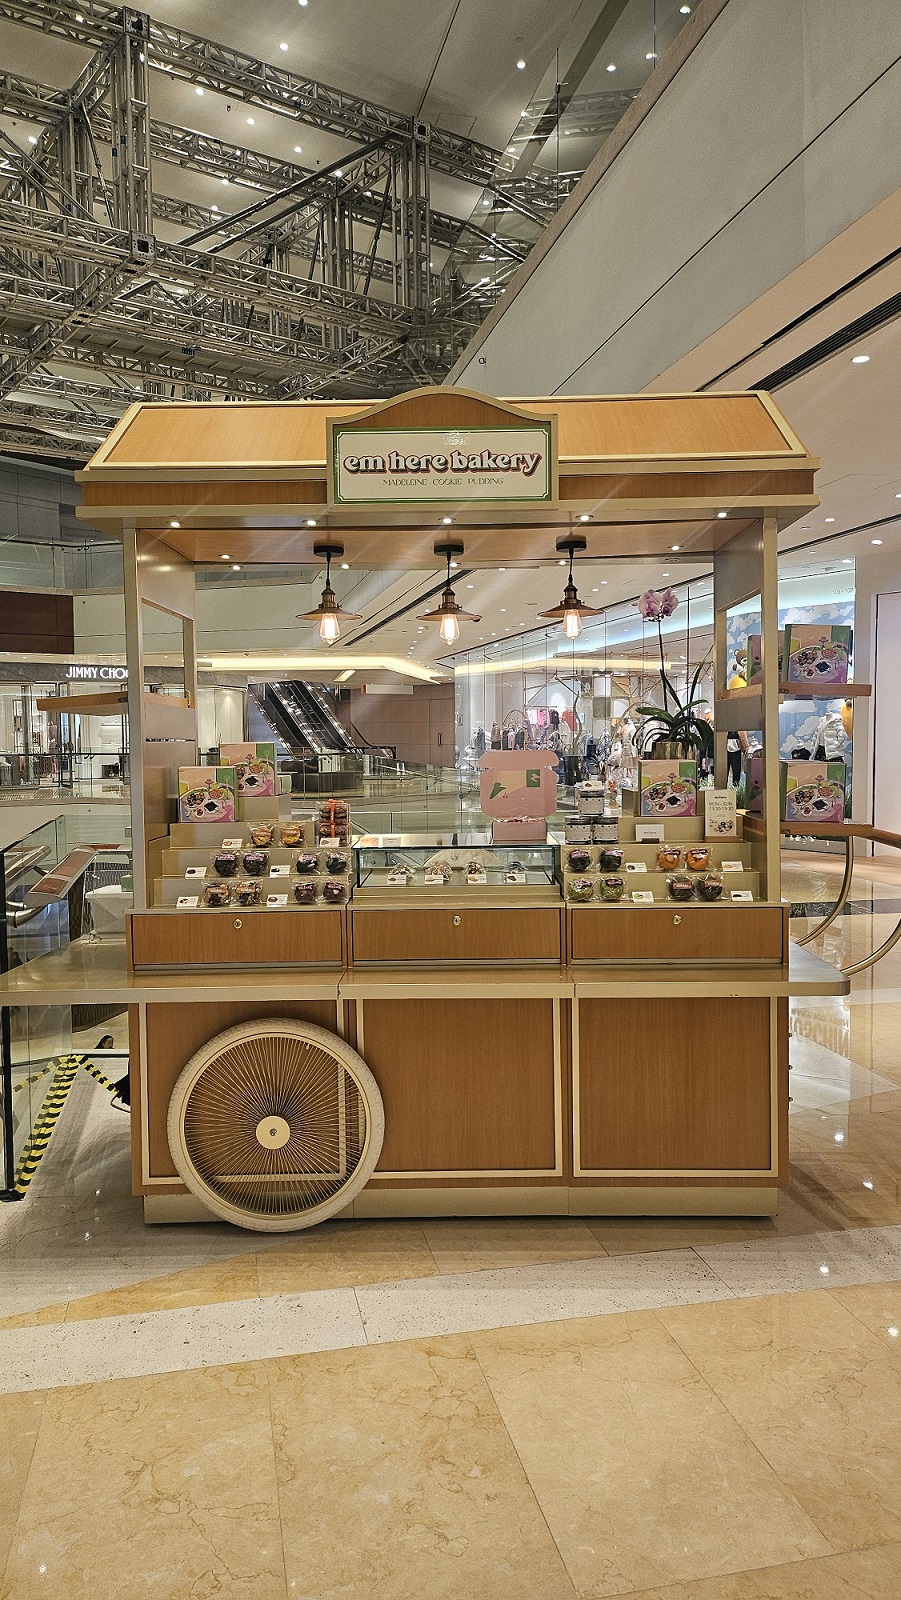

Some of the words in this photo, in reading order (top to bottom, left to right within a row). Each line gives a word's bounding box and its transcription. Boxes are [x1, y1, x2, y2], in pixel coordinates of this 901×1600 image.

[344, 455, 387, 474] em
[387, 450, 449, 474] here
[450, 449, 542, 477] bakery
[383, 478, 427, 486] MADELEINE
[432, 478, 462, 486] COOKIE
[467, 477, 504, 485] PUDDING
[65, 666, 99, 679] JIMMY
